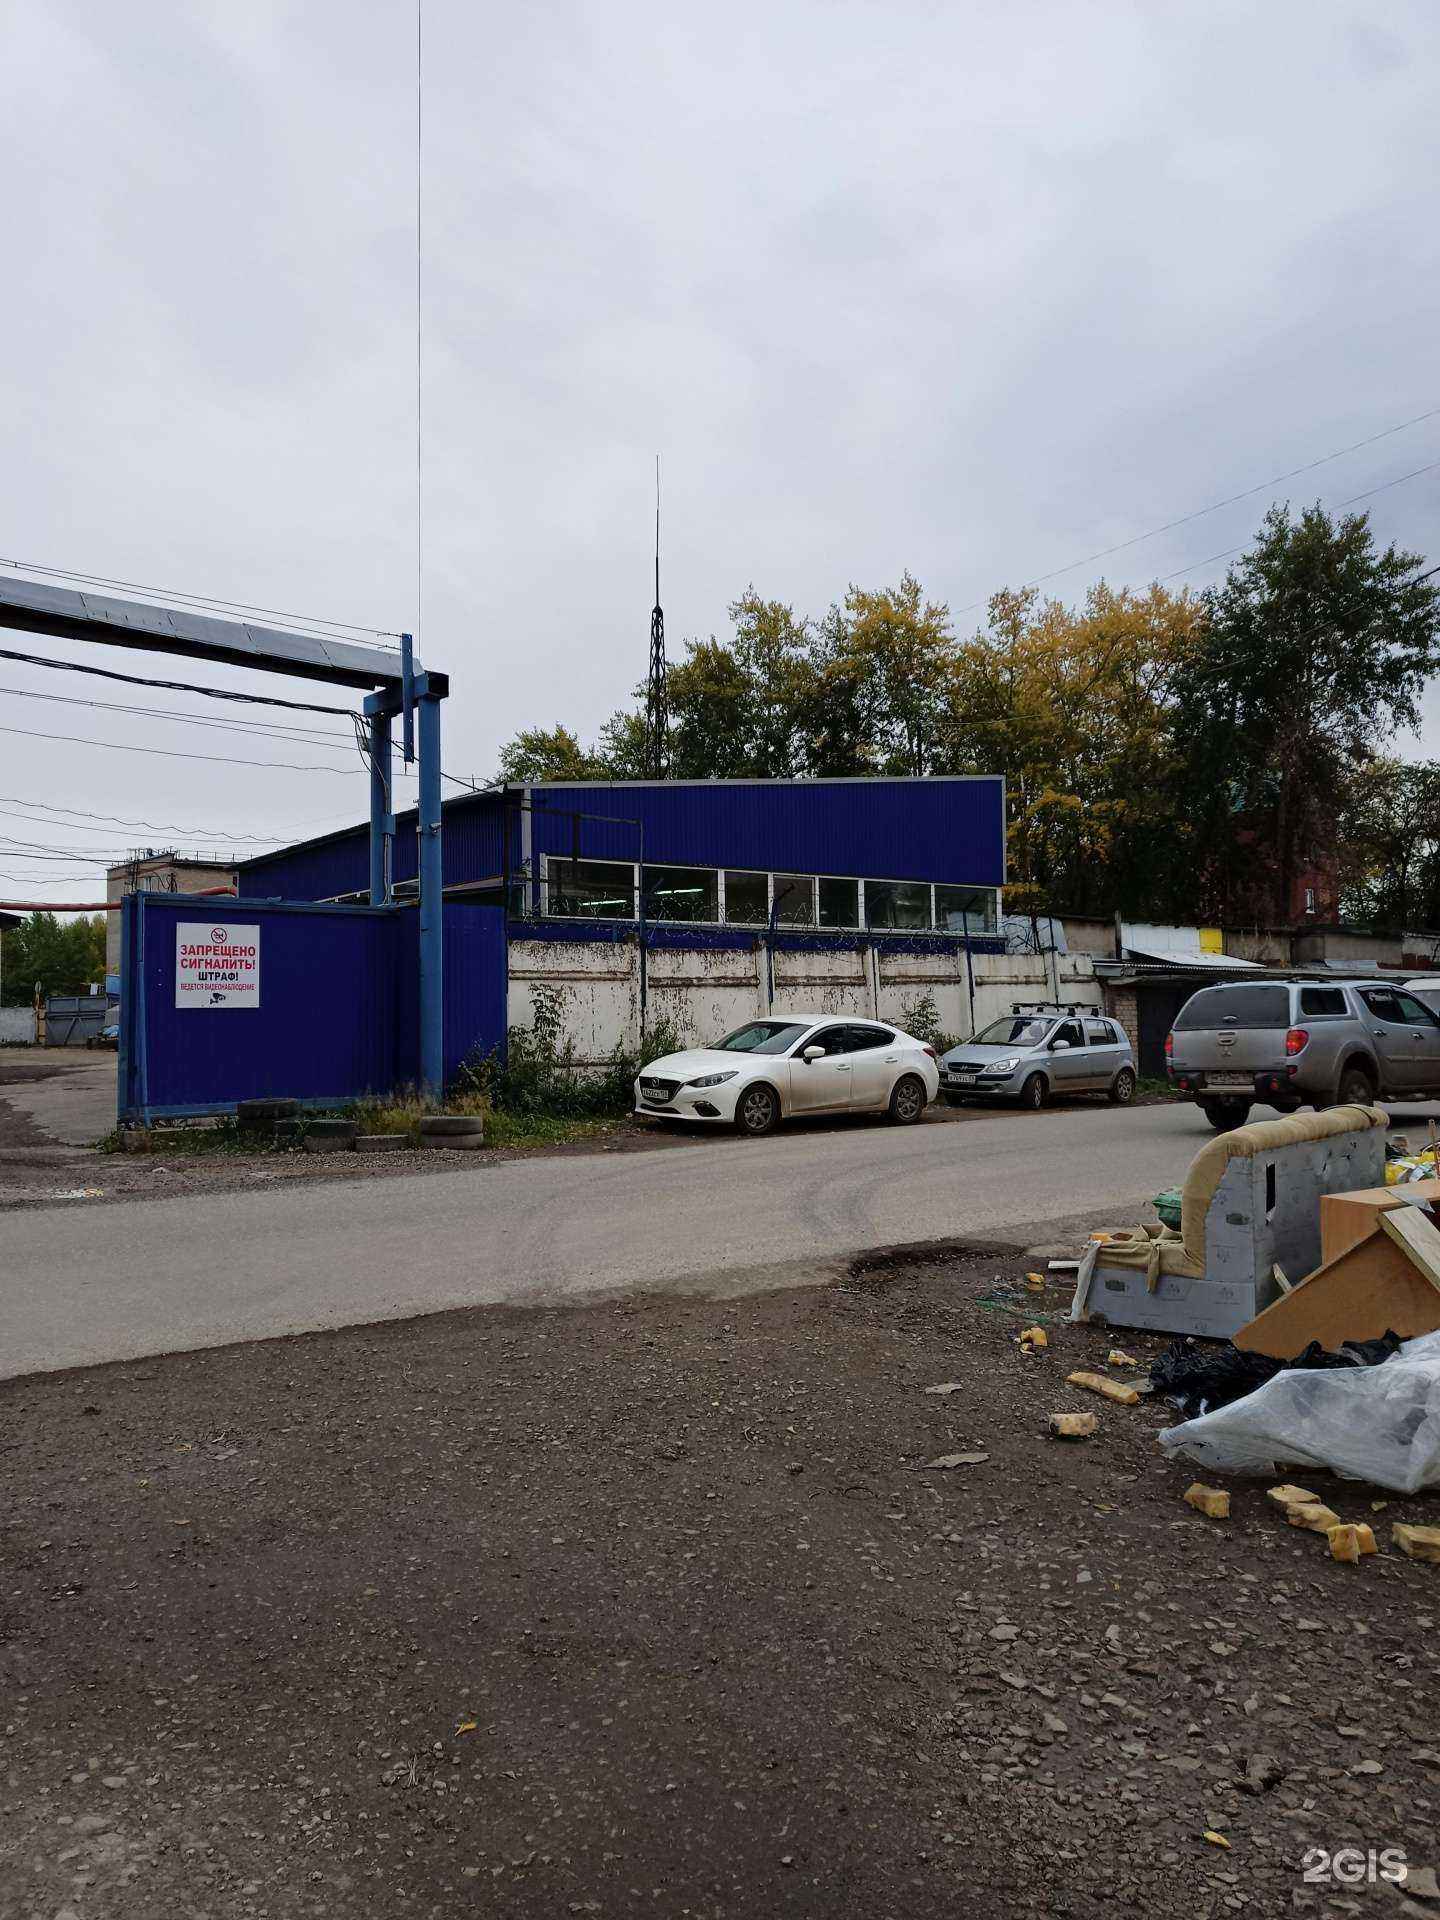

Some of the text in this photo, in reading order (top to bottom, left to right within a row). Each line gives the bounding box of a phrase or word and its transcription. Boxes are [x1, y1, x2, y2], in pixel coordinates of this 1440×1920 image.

[180, 944, 256, 958] ЗАПРЕЩЕНО
[180, 958, 256, 970] СИГНАЛИТЬ!
[198, 971, 239, 981] ШТРАФ!
